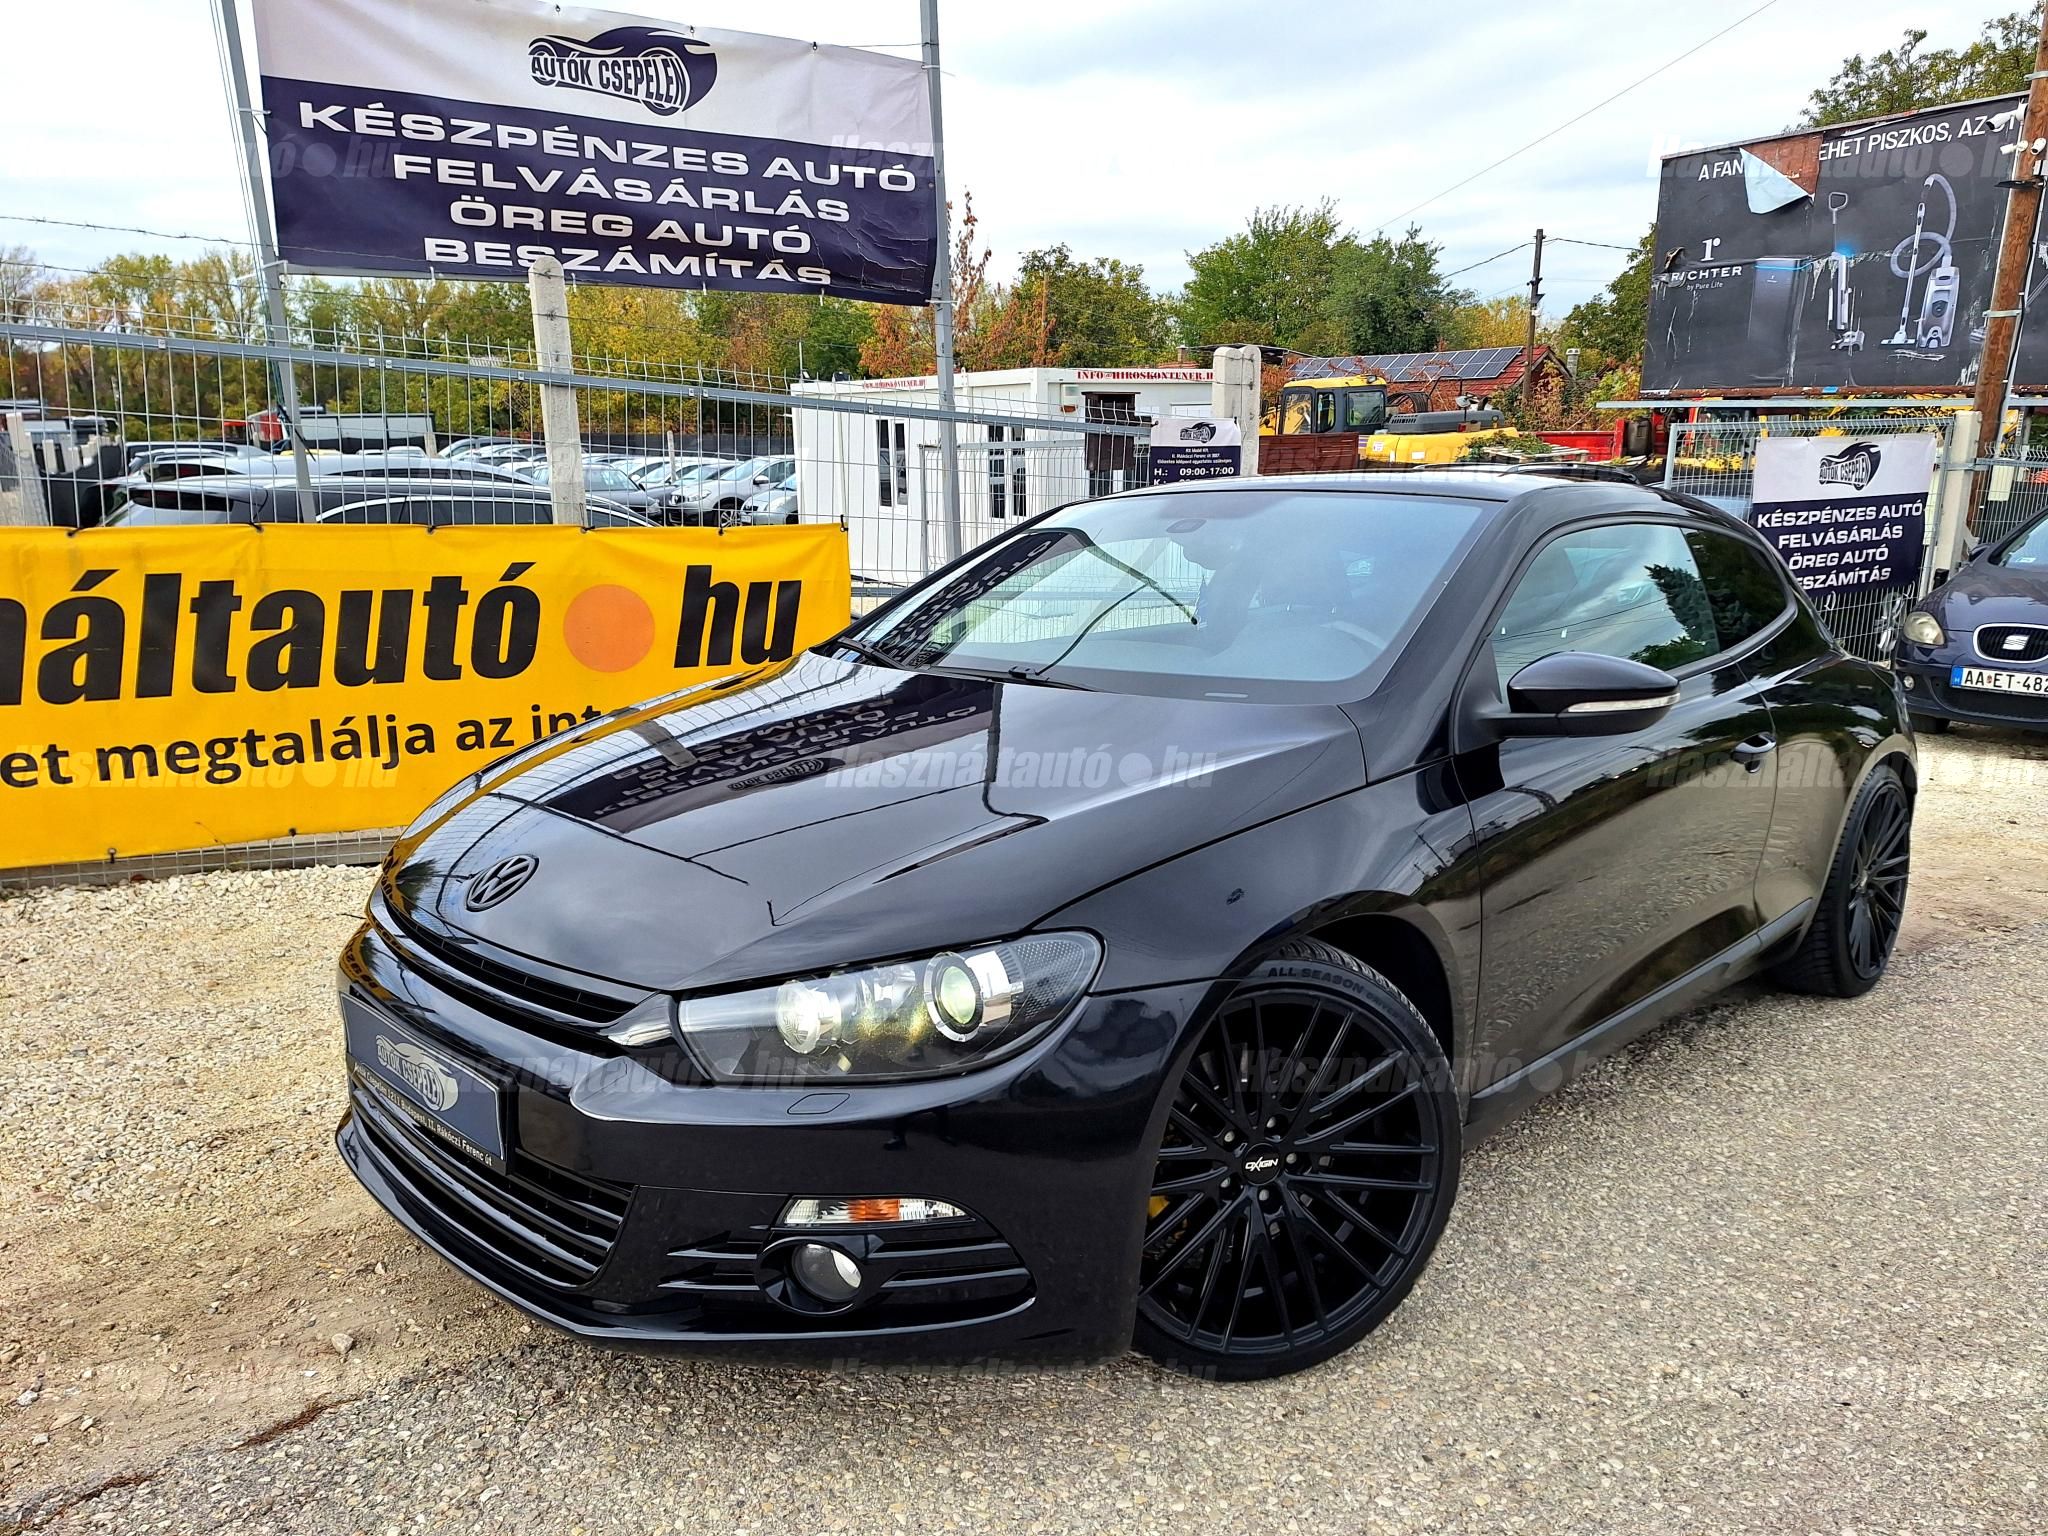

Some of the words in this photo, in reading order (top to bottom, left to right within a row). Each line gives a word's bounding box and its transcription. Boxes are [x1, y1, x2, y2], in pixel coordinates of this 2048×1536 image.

[531, 52, 593, 87] AUTÓK
[598, 57, 687, 107] CSEPELEN
[299, 101, 750, 177] KÉSZPÉNZES
[762, 157, 917, 194] AUTÓ
[1698, 165, 1711, 182] A
[1868, 123, 1953, 152] PISZKOS,
[1957, 115, 1986, 138] AZ
[393, 152, 850, 224] FELVÁSÁRLÁS
[449, 195, 633, 238] ÖREG
[646, 219, 811, 255] AUTÓ
[423, 237, 832, 287] BESZÁMÍTÁS
[1671, 266, 1743, 281] RICHTER
[1154, 468, 1168, 476] H.:
[1179, 467, 1235, 476] 09:00-17:00
[1840, 457, 1871, 486] CSEPELEN
[1757, 506, 1877, 528] KÉSZPÉNZES
[1878, 499, 1923, 519] AUTÓ
[1778, 522, 1903, 549] FELVÁSÁRLÁS
[1788, 552, 1840, 570] ÖREG
[1841, 543, 1889, 565] AUTÓ
[674, 564, 803, 669] hu
[1964, 670, 1985, 686] AA
[98, 708, 436, 788] megtalálja
[455, 717, 516, 752] az
[1267, 967, 1297, 978] ALL
[1302, 968, 1364, 994] SEASON
[462, 1138, 484, 1162] Ferenc
[485, 1152, 492, 1166] út
[1245, 1156, 1279, 1171] OXIGIN
